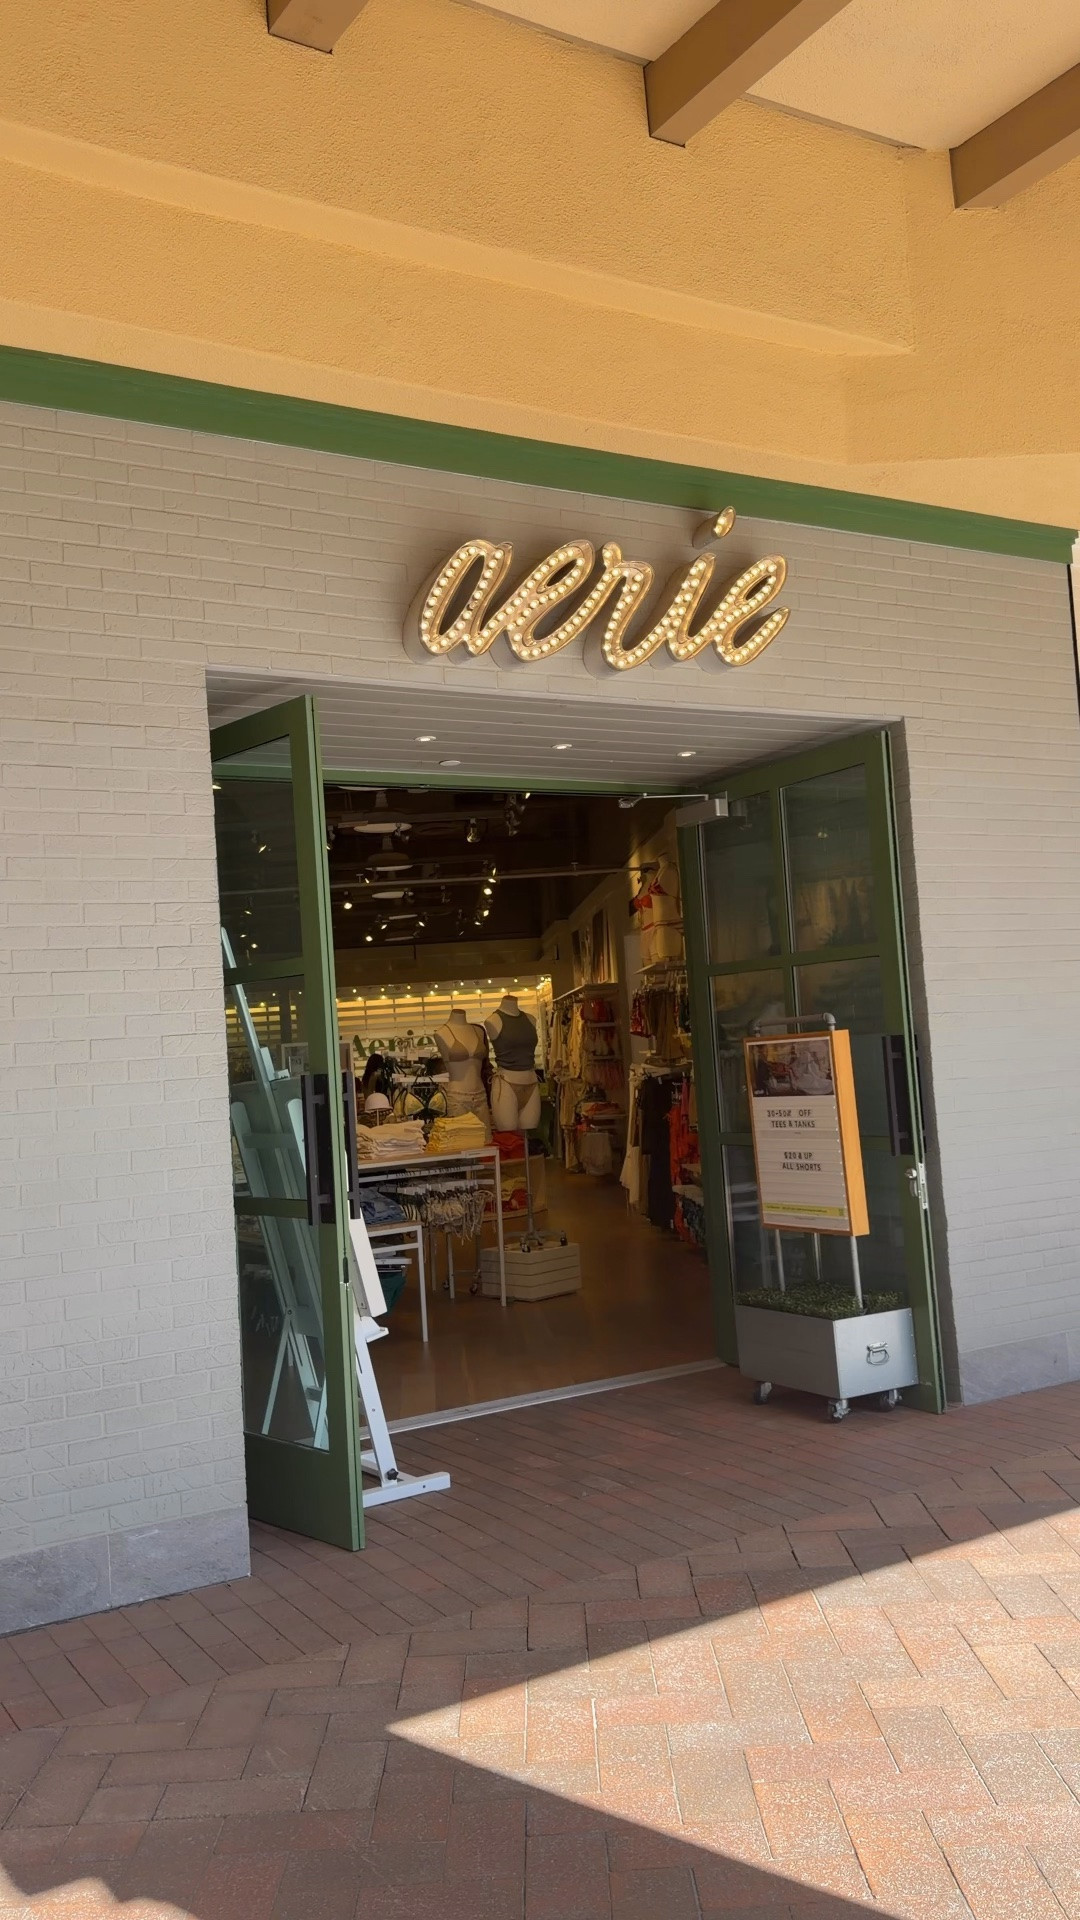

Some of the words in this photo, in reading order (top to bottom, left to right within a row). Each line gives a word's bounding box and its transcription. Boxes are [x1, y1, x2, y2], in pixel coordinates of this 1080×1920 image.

[418, 505, 791, 671] aerie
[798, 1109, 811, 1117] OFF
[771, 1120, 786, 1128] TEES
[794, 1120, 815, 1128] TANKS
[784, 1151, 797, 1160] $20
[803, 1152, 812, 1160] UP
[782, 1162, 793, 1170] ALL
[796, 1163, 821, 1171] SHORTS
